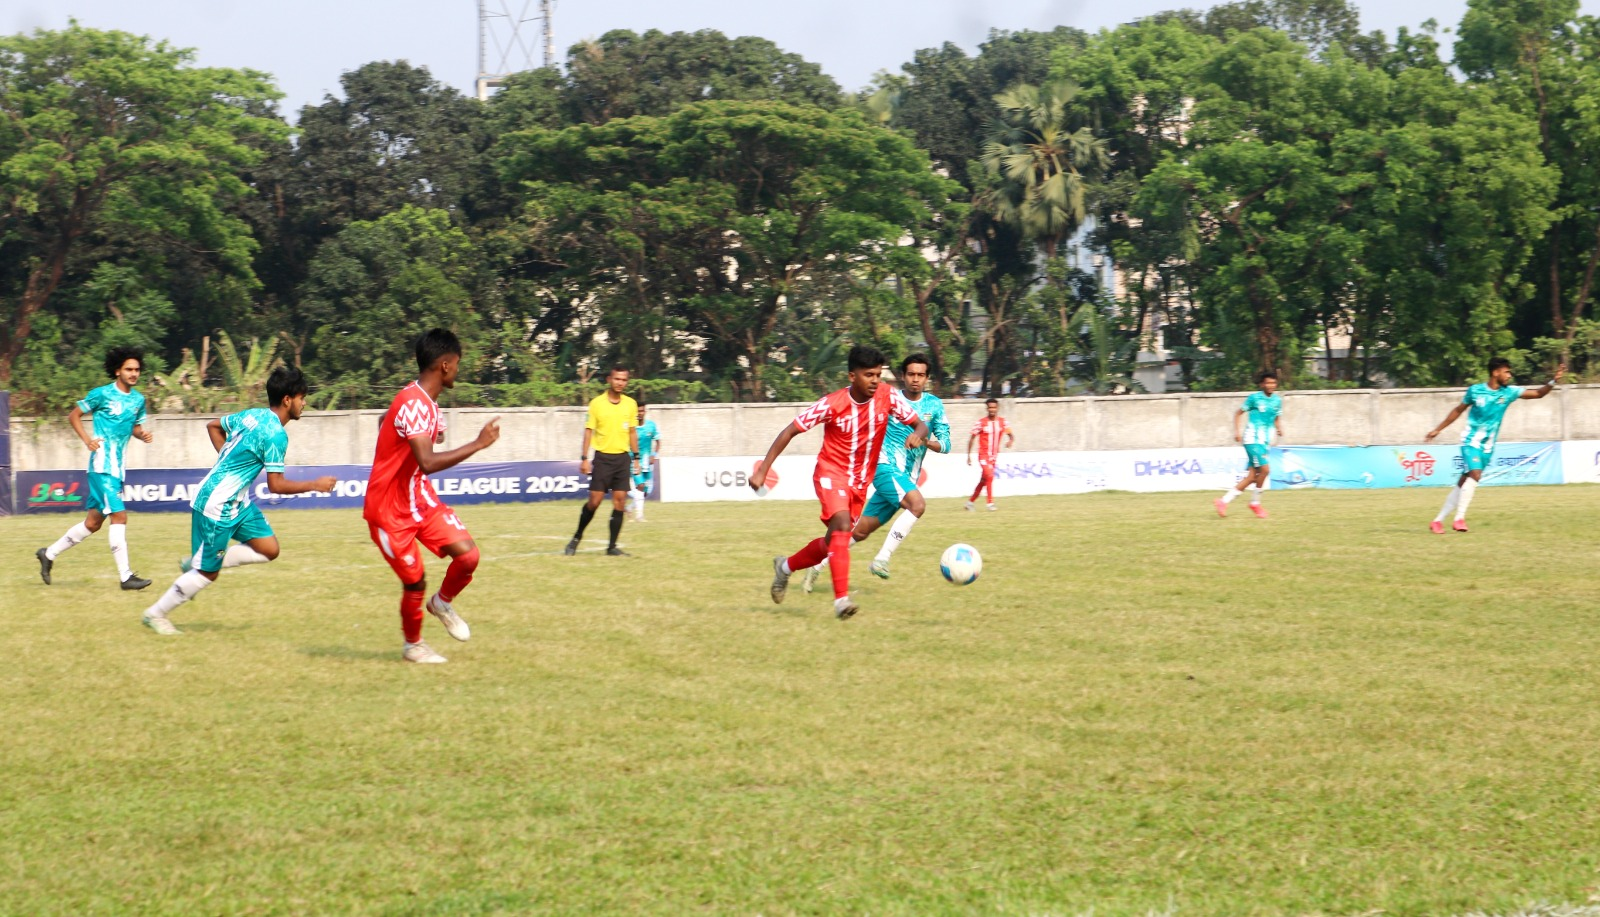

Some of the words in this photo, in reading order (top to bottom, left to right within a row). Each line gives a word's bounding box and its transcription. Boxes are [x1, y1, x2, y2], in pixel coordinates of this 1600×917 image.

[431, 477, 521, 495] LEAGUE
[525, 475, 592, 493] 2025-
[704, 470, 747, 487] UCB
[28, 482, 82, 502] BCL
